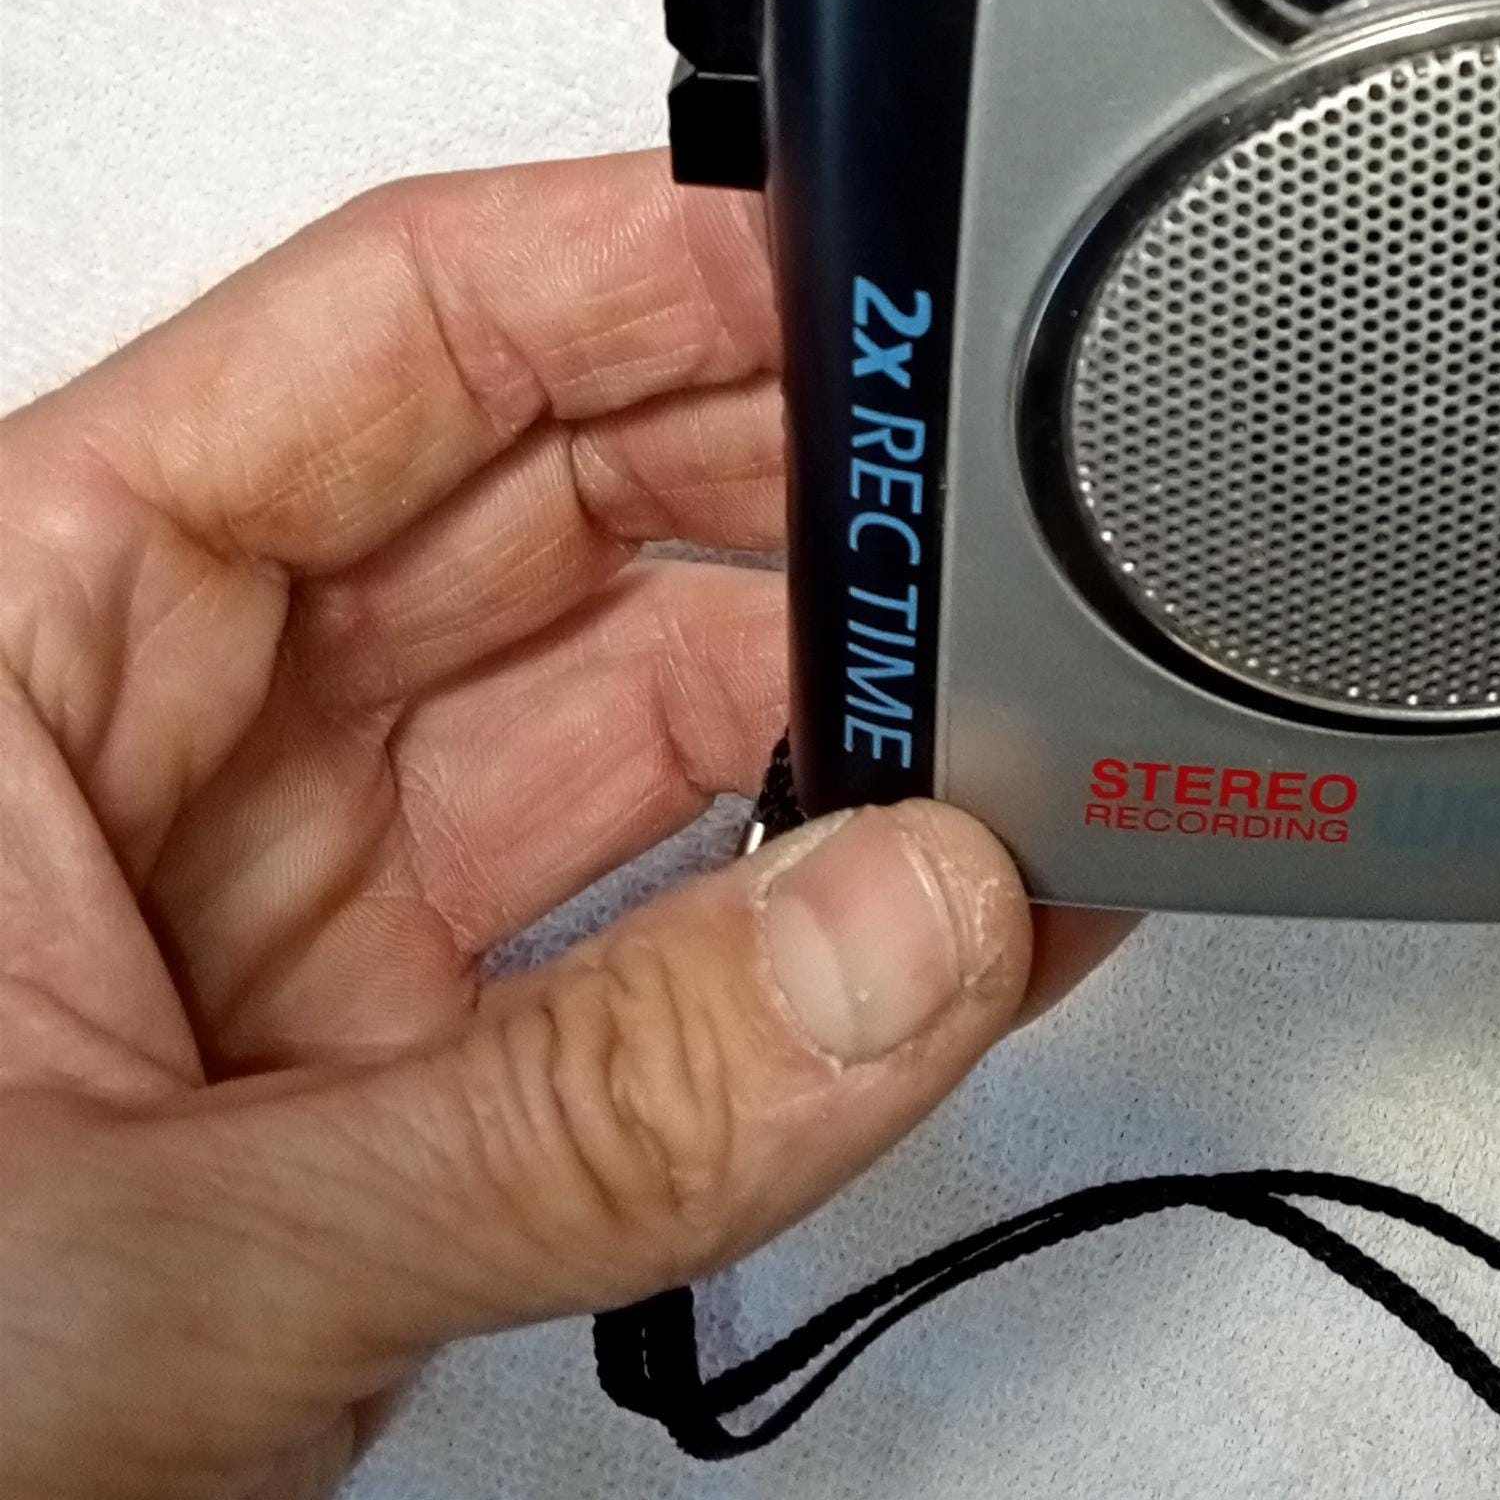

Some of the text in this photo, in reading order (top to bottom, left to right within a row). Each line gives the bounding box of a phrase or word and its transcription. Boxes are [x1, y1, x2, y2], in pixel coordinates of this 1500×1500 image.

[847, 403, 926, 566] REC
[843, 584, 919, 769] TIME
[1084, 802, 1350, 844] RECORDING
[1088, 757, 1359, 815] STEREO
